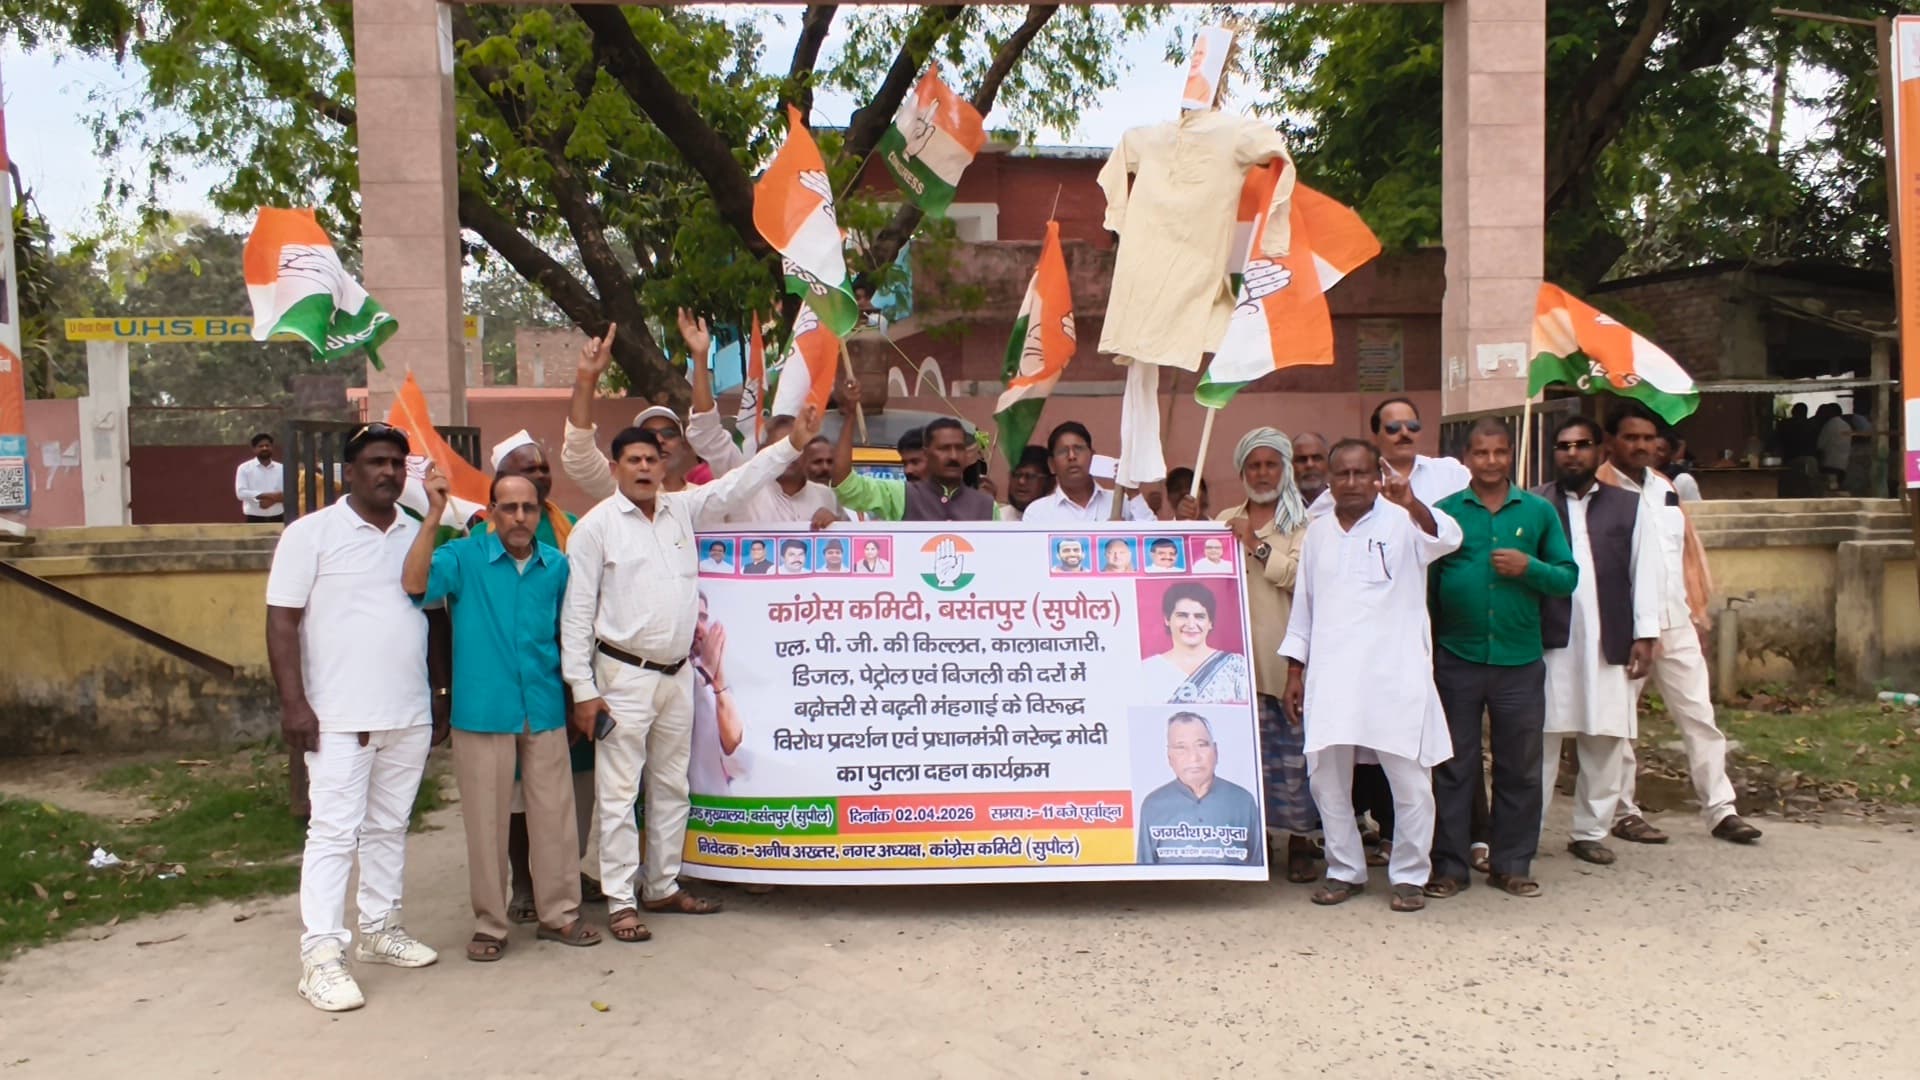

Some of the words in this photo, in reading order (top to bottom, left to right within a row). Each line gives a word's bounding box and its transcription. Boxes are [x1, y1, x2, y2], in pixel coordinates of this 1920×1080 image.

[768, 592, 844, 624] कांग्रेस
[849, 592, 931, 623] कमिटी,
[938, 593, 1026, 631] बसंतपुर
[1033, 591, 1121, 631] (सुपौल)
[775, 640, 811, 657] एल.
[816, 632, 841, 653] पी.
[846, 632, 878, 653] जी.
[884, 632, 908, 654] की
[913, 632, 985, 656] किल्लत,
[991, 631, 1105, 653] कालाबाजारी,
[792, 664, 854, 687] डिजल,
[860, 664, 908, 691] पेट्रोल
[912, 664, 938, 686] एवं
[942, 664, 1003, 685] बिजली
[1008, 663, 1032, 684] की
[1037, 663, 1066, 684] दरों
[1070, 663, 1087, 682] में
[860, 695, 878, 717] से
[882, 694, 927, 721] बढ़ती
[931, 693, 998, 718] मंहगाई
[1001, 693, 1022, 714] के
[773, 727, 824, 751] विरोध
[827, 726, 888, 752] प्रदर्शन
[892, 726, 918, 749] एवं
[922, 725, 1009, 750] प्रधानमंत्री
[1012, 724, 1062, 748] नरेन्द्र
[1066, 723, 1107, 745] मोदी
[837, 764, 863, 783] का
[867, 763, 920, 791] पुतला
[924, 763, 968, 782] दहन
[971, 757, 1050, 781] कार्यक्रम
[849, 808, 891, 824] दिनांक
[895, 807, 975, 822] 02.04.2026
[991, 806, 1024, 820] समय
[1151, 823, 1200, 839] जगदीश
[1218, 827, 1247, 845] गुप्ता
[697, 836, 739, 856] निवेदक
[843, 844, 875, 858] नगर
[929, 838, 975, 858] कांग्रेस
[977, 837, 1022, 855] कमिटी
[1026, 836, 1080, 861] (सुपौल)
